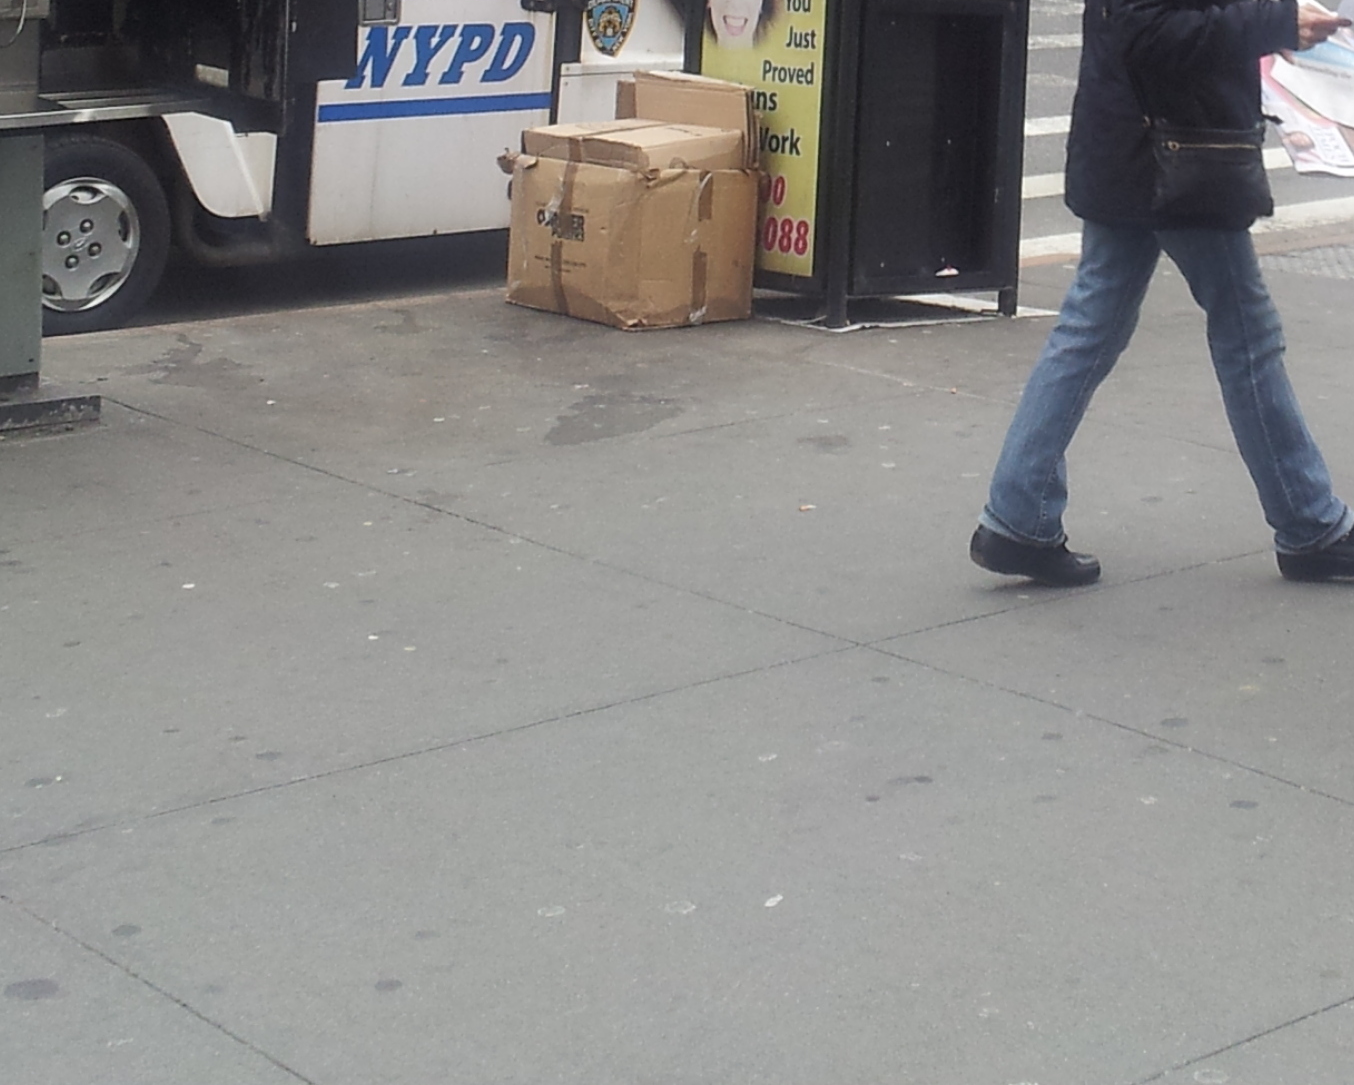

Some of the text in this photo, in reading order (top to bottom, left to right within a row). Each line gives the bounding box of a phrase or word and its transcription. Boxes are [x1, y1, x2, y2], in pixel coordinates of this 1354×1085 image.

[786, 26, 816, 50] Just
[344, 21, 537, 89] NYPD
[763, 60, 814, 86] Proved
[751, 90, 778, 111] ns
[763, 216, 809, 256] 088
